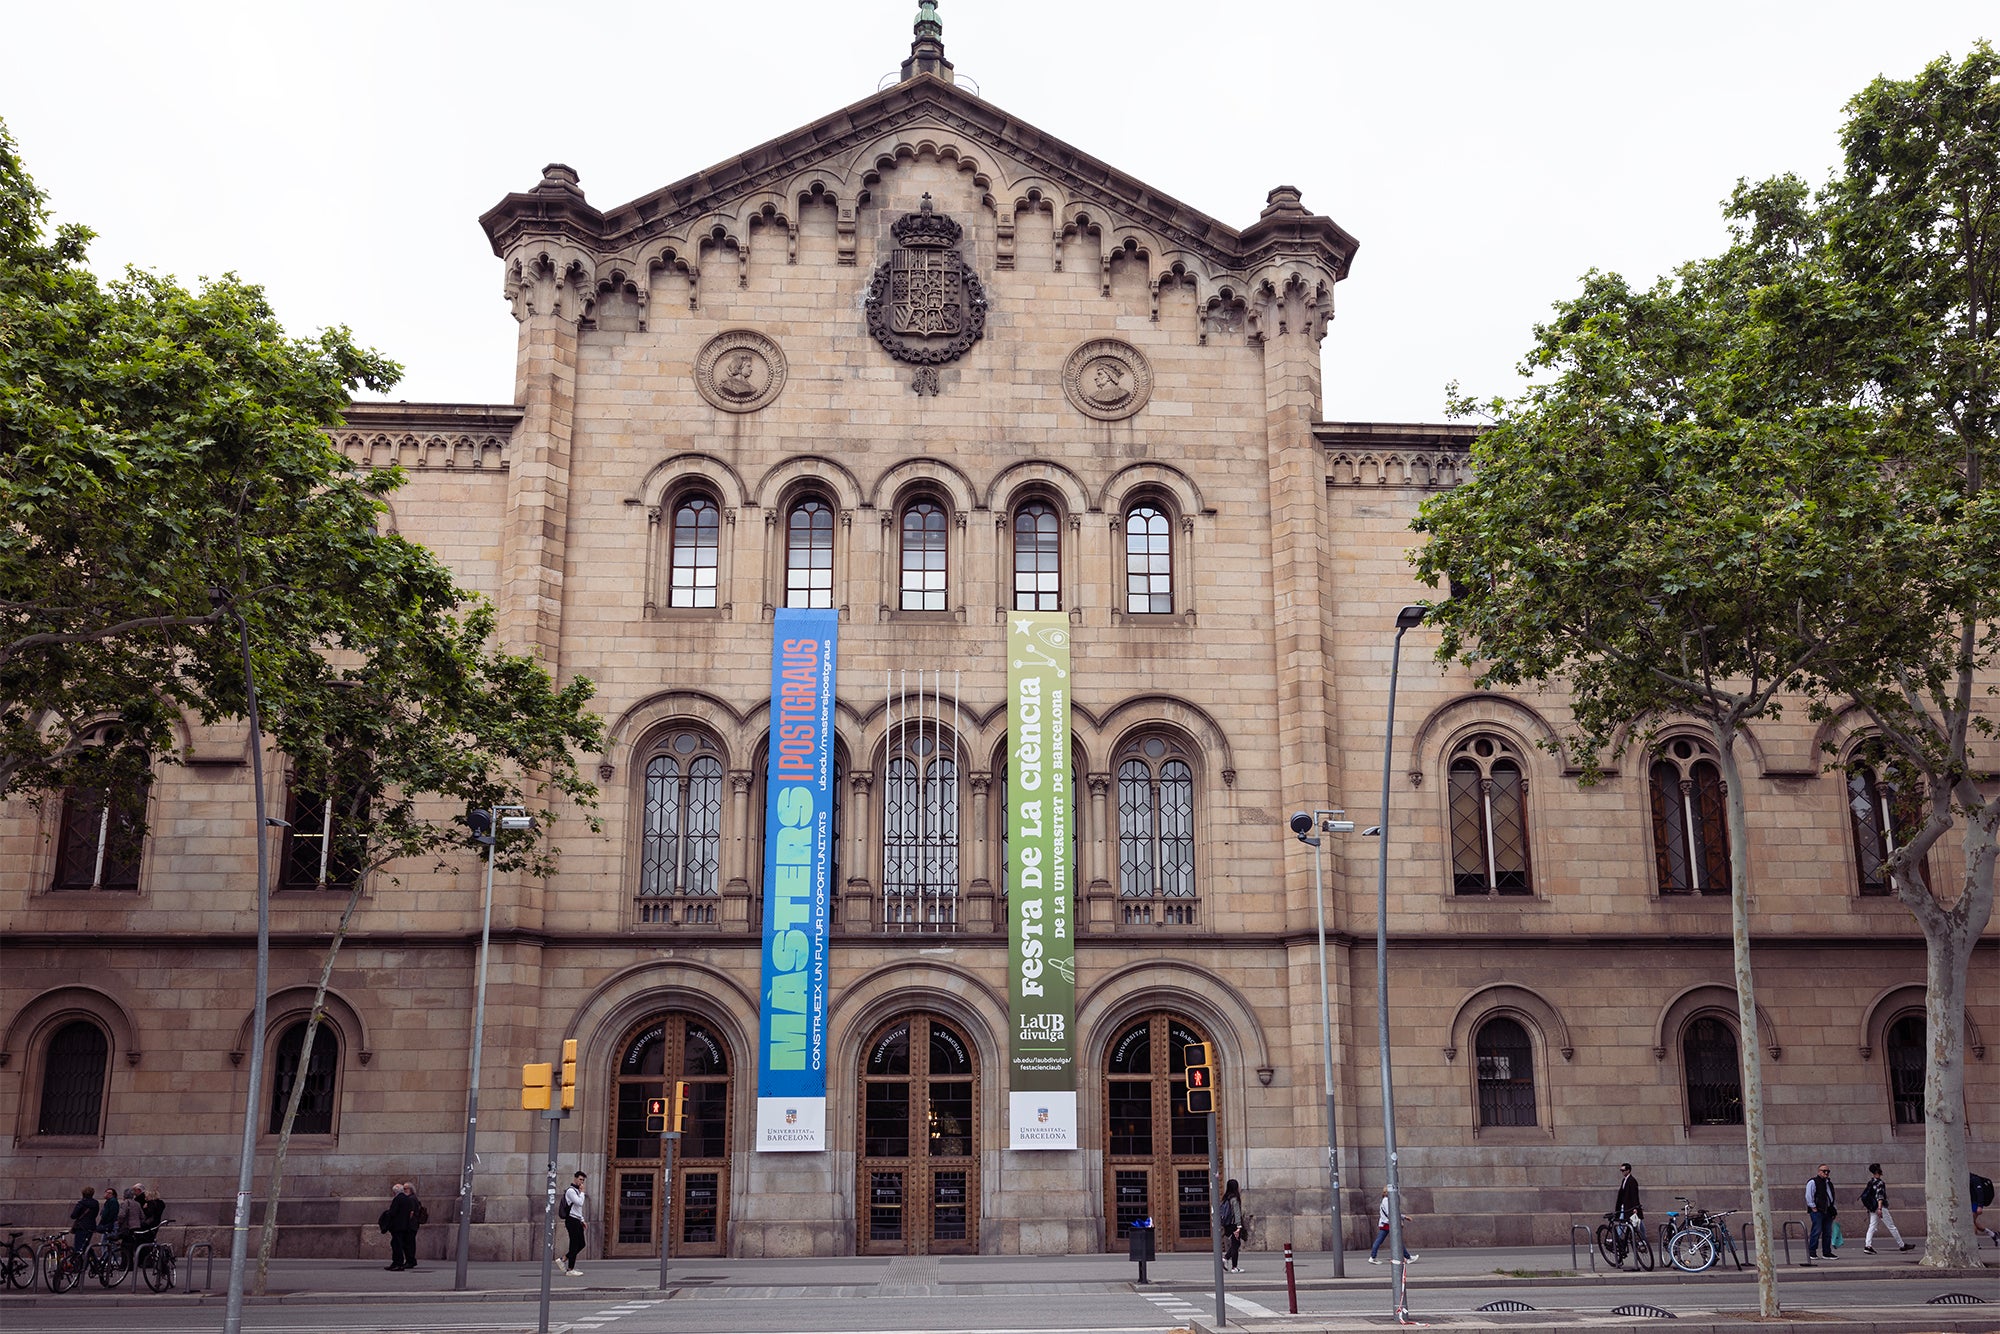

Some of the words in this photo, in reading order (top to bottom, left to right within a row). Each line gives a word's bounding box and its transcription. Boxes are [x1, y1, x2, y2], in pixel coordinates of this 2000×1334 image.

[778, 639, 818, 770] POSTGRAUS
[820, 639, 831, 791] ub.edu/mastersipostgraus
[767, 786, 814, 1070] MÀSTERS
[815, 918, 824, 964] FUTUR
[814, 966, 822, 981] UN
[812, 984, 822, 1070] CONSTRUEIX
[1019, 1029, 1065, 1042] divulga
[1020, 1013, 1065, 1031] LaUB
[696, 1031, 719, 1064] BARCELONA
[940, 1031, 965, 1064] BARCELONA
[1013, 1057, 1072, 1065] ub.edu/laubdivulga/
